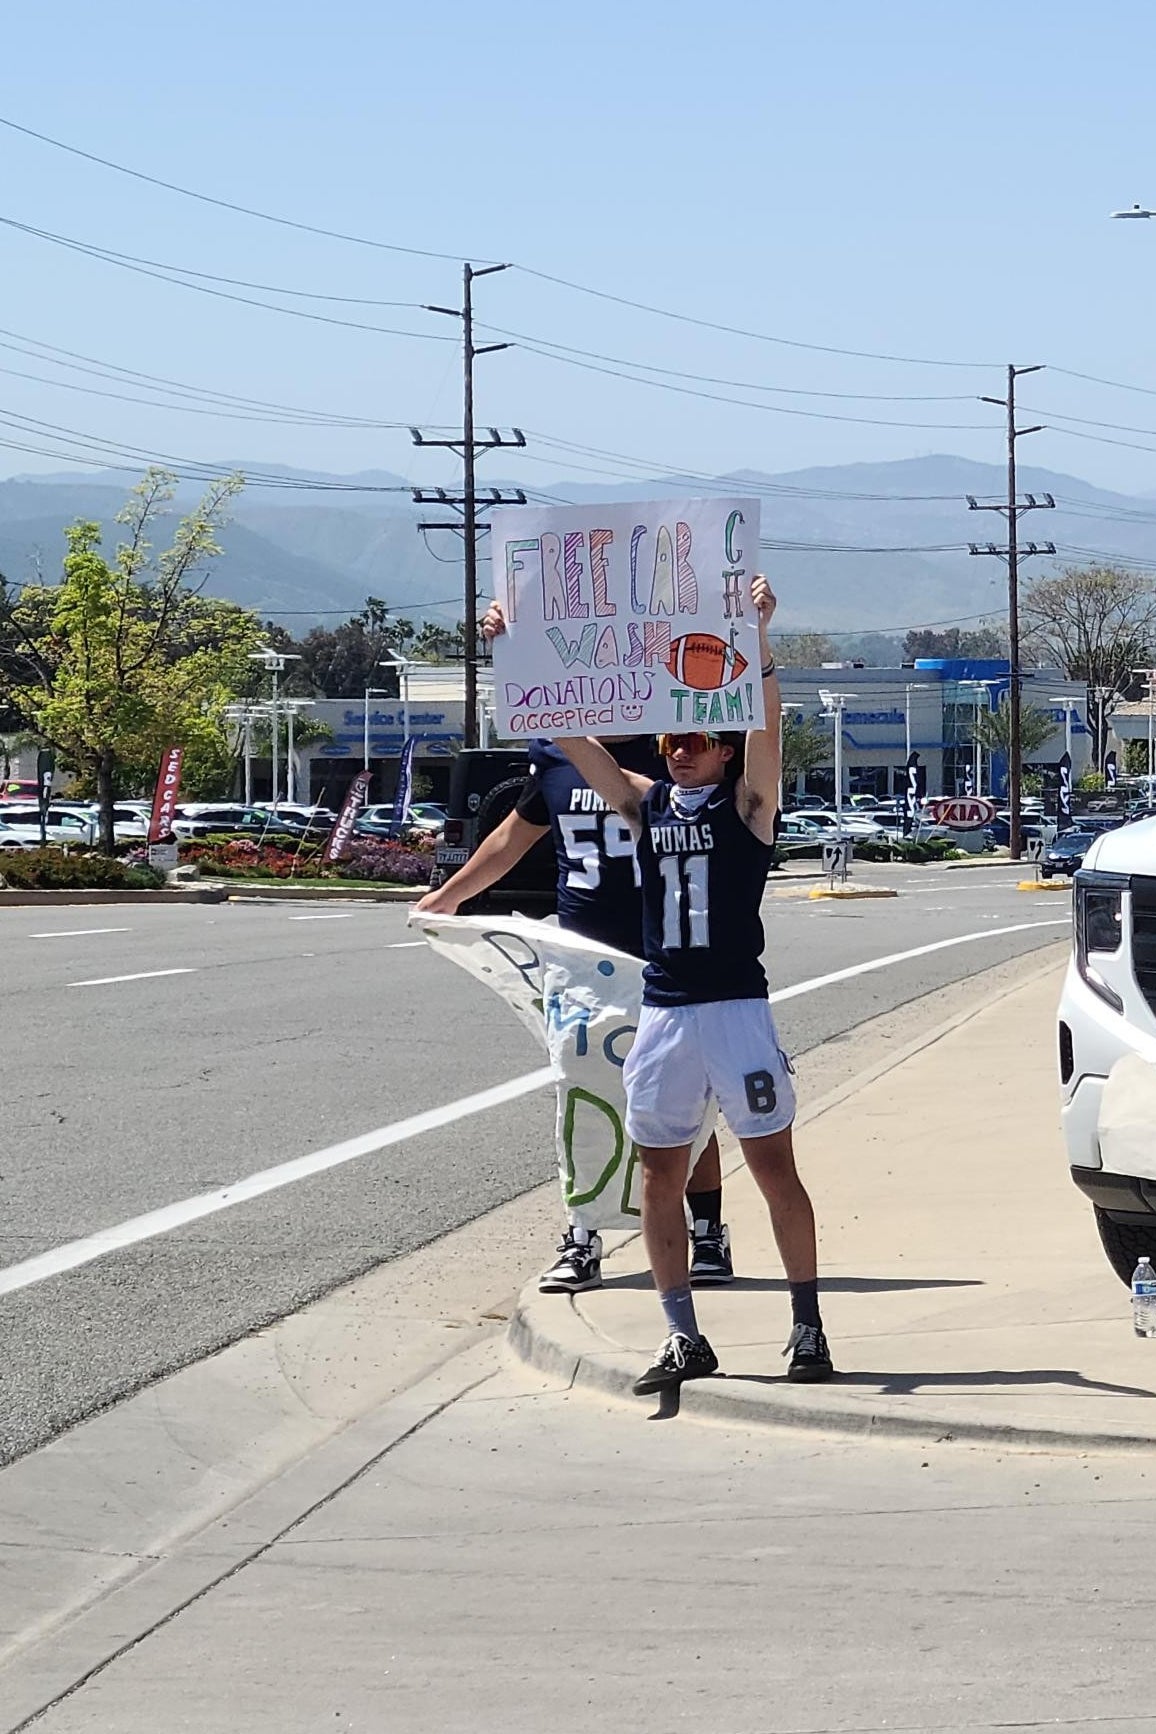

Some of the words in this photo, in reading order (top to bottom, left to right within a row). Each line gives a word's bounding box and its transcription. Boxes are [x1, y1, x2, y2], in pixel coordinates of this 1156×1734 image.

[505, 529, 616, 623] FREE
[630, 521, 698, 615] CAR
[545, 621, 671, 668] WASH
[505, 671, 656, 709] DONATIONS
[670, 683, 754, 725] TEAM!
[510, 704, 614, 733] accepted
[942, 803, 983, 822] KIA
[557, 813, 642, 890] 59
[650, 824, 714, 854] PUMAS
[659, 854, 710, 949] 11
[743, 1070, 777, 1114] B
